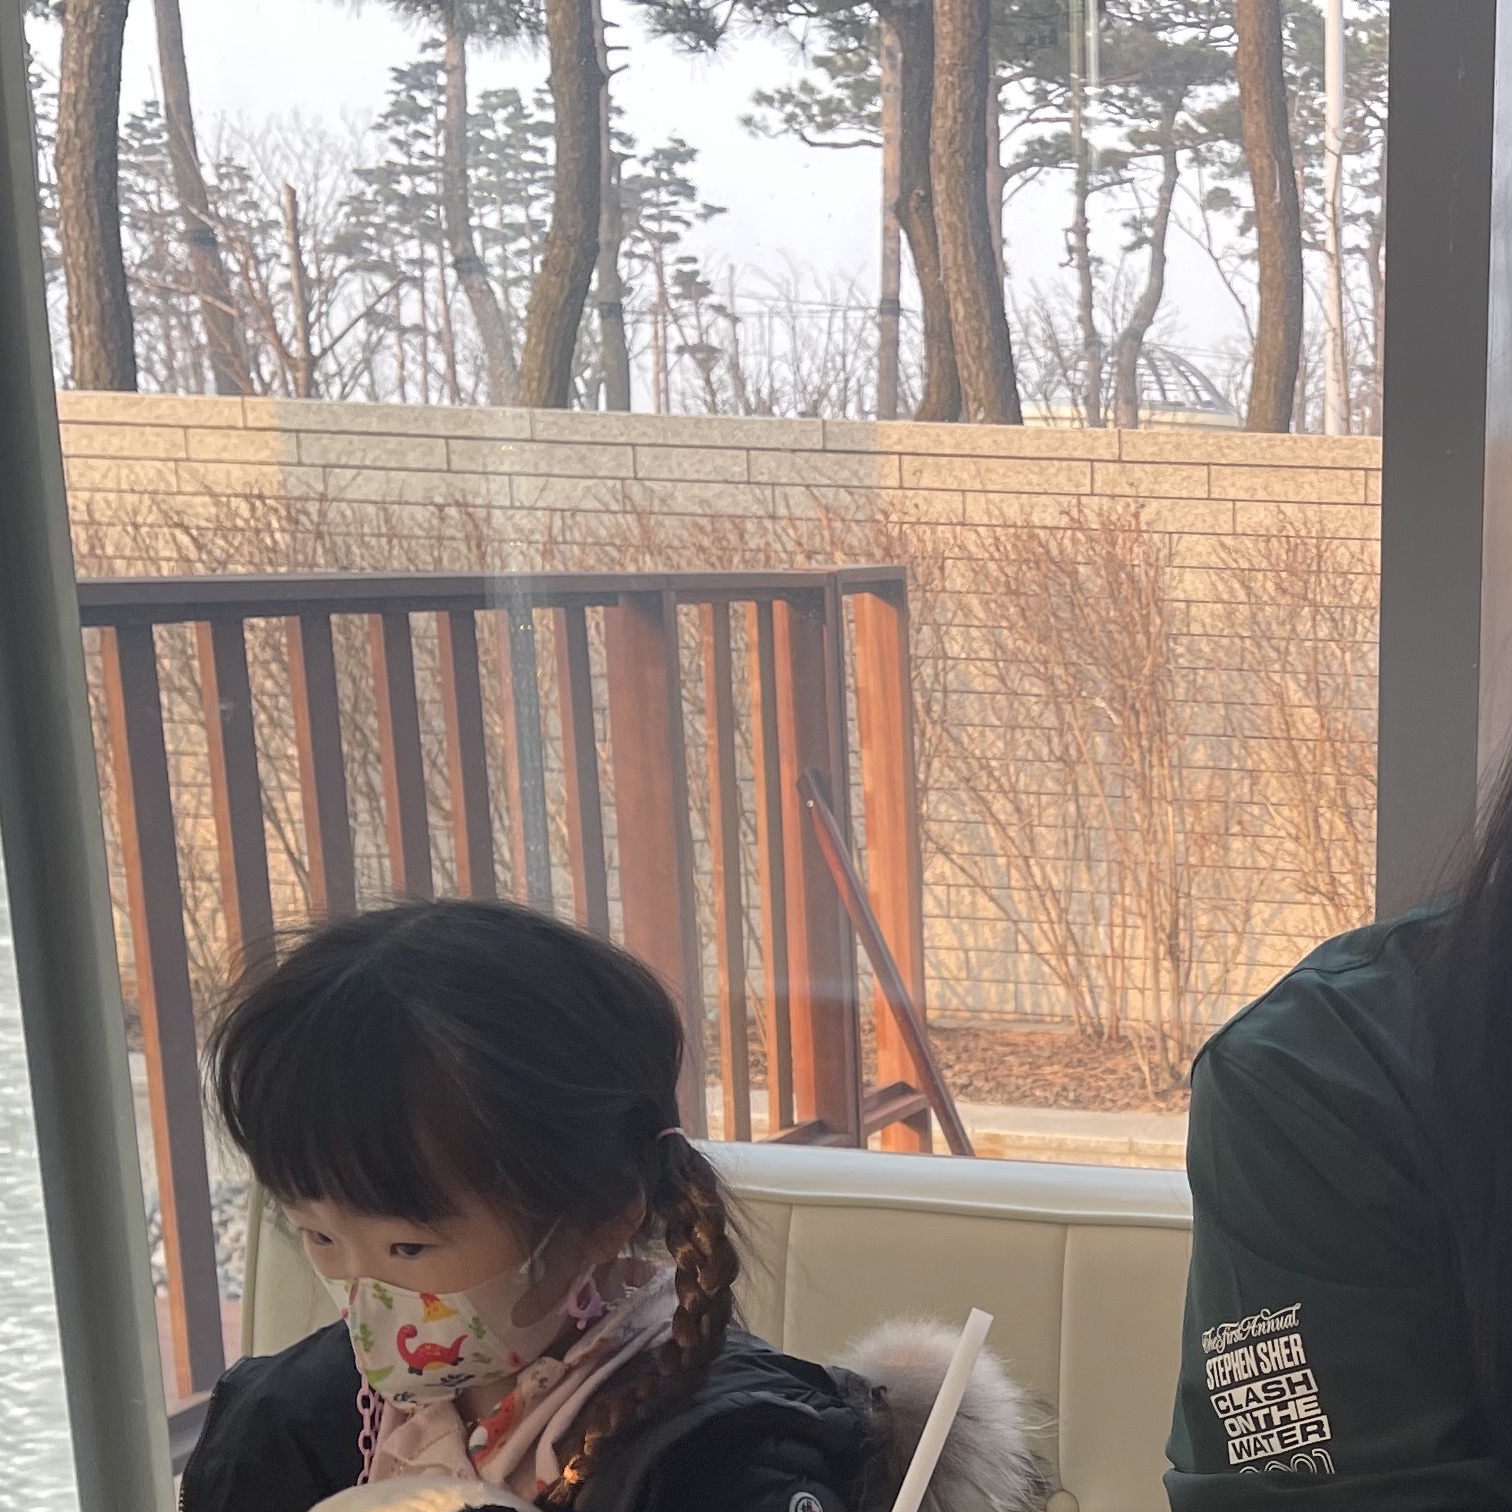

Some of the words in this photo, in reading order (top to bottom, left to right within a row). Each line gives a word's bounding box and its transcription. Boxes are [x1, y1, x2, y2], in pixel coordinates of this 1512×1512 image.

[1241, 1302, 1302, 1340] Annual
[1205, 1345, 1260, 1391] STEPHEN
[1257, 1333, 1307, 1376] SHER
[1214, 1372, 1315, 1415] CLASH
[1223, 1413, 1257, 1438] ON
[1251, 1394, 1323, 1431] THE
[1230, 1418, 1327, 1461] WATER
